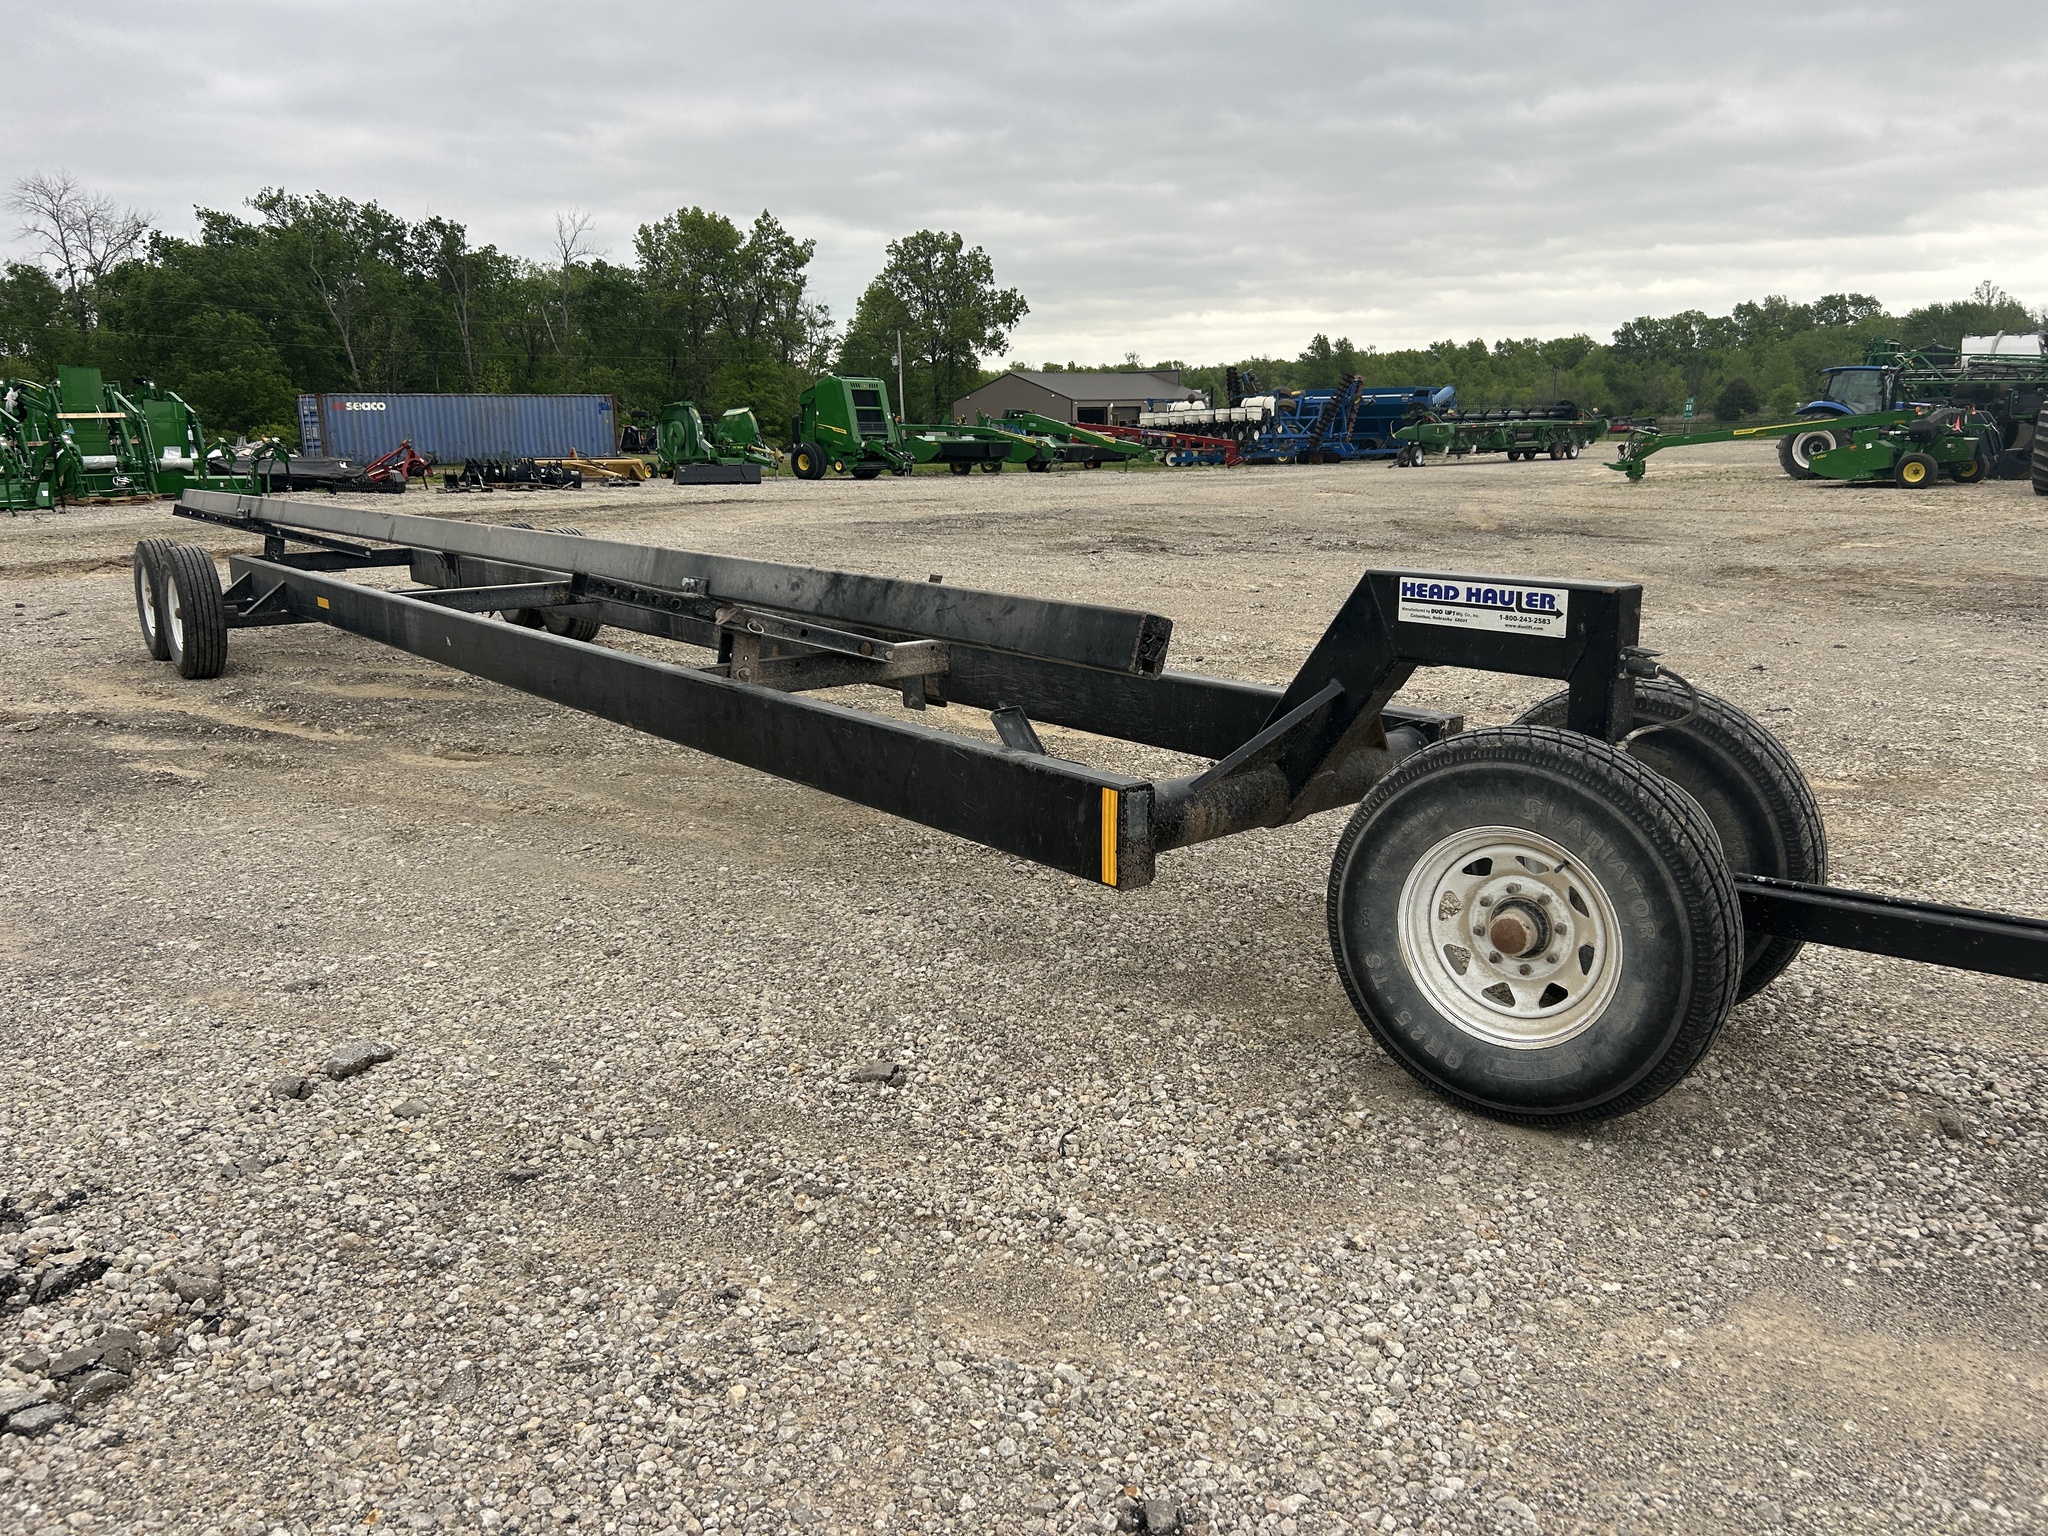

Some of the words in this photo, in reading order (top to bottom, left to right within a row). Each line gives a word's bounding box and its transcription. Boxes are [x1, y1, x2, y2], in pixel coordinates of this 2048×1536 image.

[345, 401, 386, 411] seaco
[1402, 582, 1460, 600] HEAD
[1466, 587, 1556, 610] HAULER
[1499, 614, 1551, 625] 1-800-243-2583
[1504, 623, 1544, 631] www.duolift.com
[1522, 797, 1657, 940] GLADIATOR
